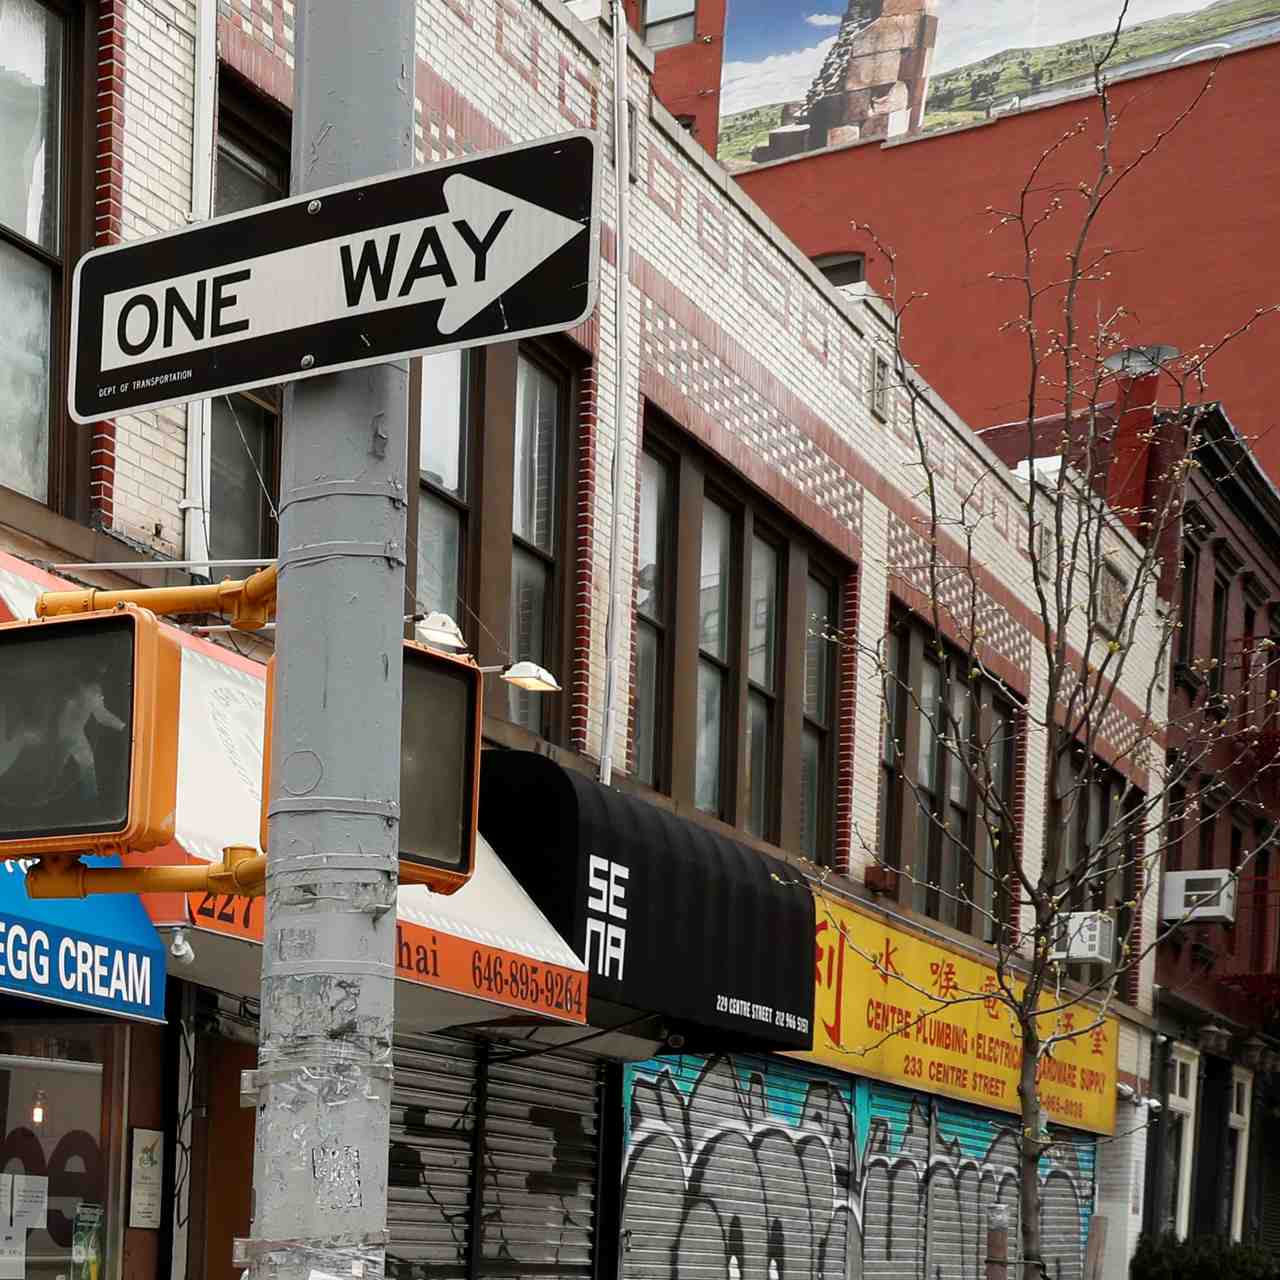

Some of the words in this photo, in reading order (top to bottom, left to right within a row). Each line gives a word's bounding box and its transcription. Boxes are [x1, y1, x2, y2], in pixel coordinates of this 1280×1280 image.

[116, 268, 251, 356] ONE
[340, 209, 514, 307] WAY
[99, 386, 116, 397] DEPT
[120, 383, 128, 392] OF
[133, 369, 192, 390] TRANSPORTATION
[59, 935, 151, 1006] CREAM
[396, 927, 439, 977] hai
[471, 950, 583, 1015] 646-895-9264
[867, 998, 911, 1039] CENTRE
[916, 1015, 967, 1055] PLUMBING
[904, 1055, 922, 1077] 233
[929, 1062, 968, 1088] CENTRE
[972, 1072, 1006, 1098] STREET
